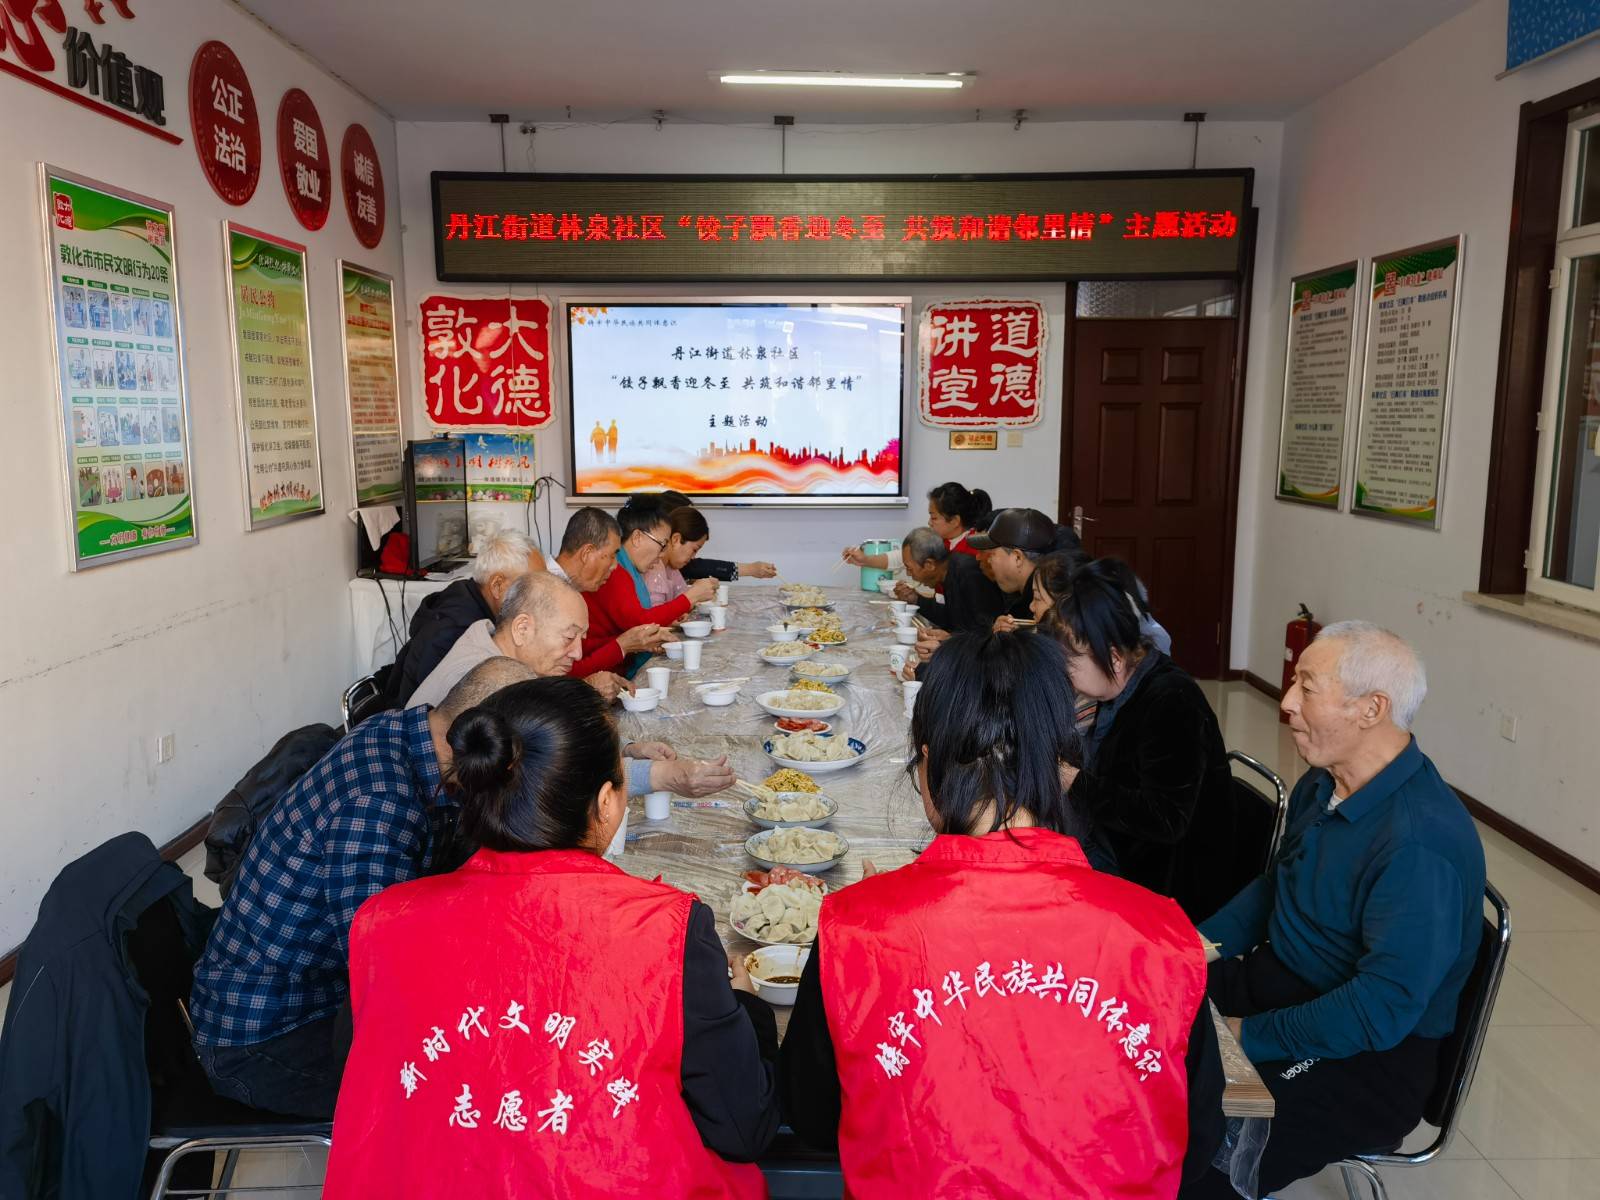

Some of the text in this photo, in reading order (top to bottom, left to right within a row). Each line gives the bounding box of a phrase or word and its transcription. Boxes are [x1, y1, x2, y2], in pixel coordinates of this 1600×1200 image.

[63, 26, 166, 126] 价值观
[211, 75, 245, 125] 公正
[213, 124, 247, 174] 法治
[292, 118, 319, 161] 爱国
[295, 163, 322, 203] 敬业
[356, 190, 378, 226] 友善
[59, 243, 169, 284] 敦化市市民文明行为20条
[671, 345, 801, 361] 丹江街道林泉社区
[708, 414, 769, 429] 主题活动
[874, 958, 1162, 1082] 铸牢中华民族共同体意识
[399, 999, 640, 1119] 新时代文明实践
[449, 1083, 575, 1135] 志愿者
